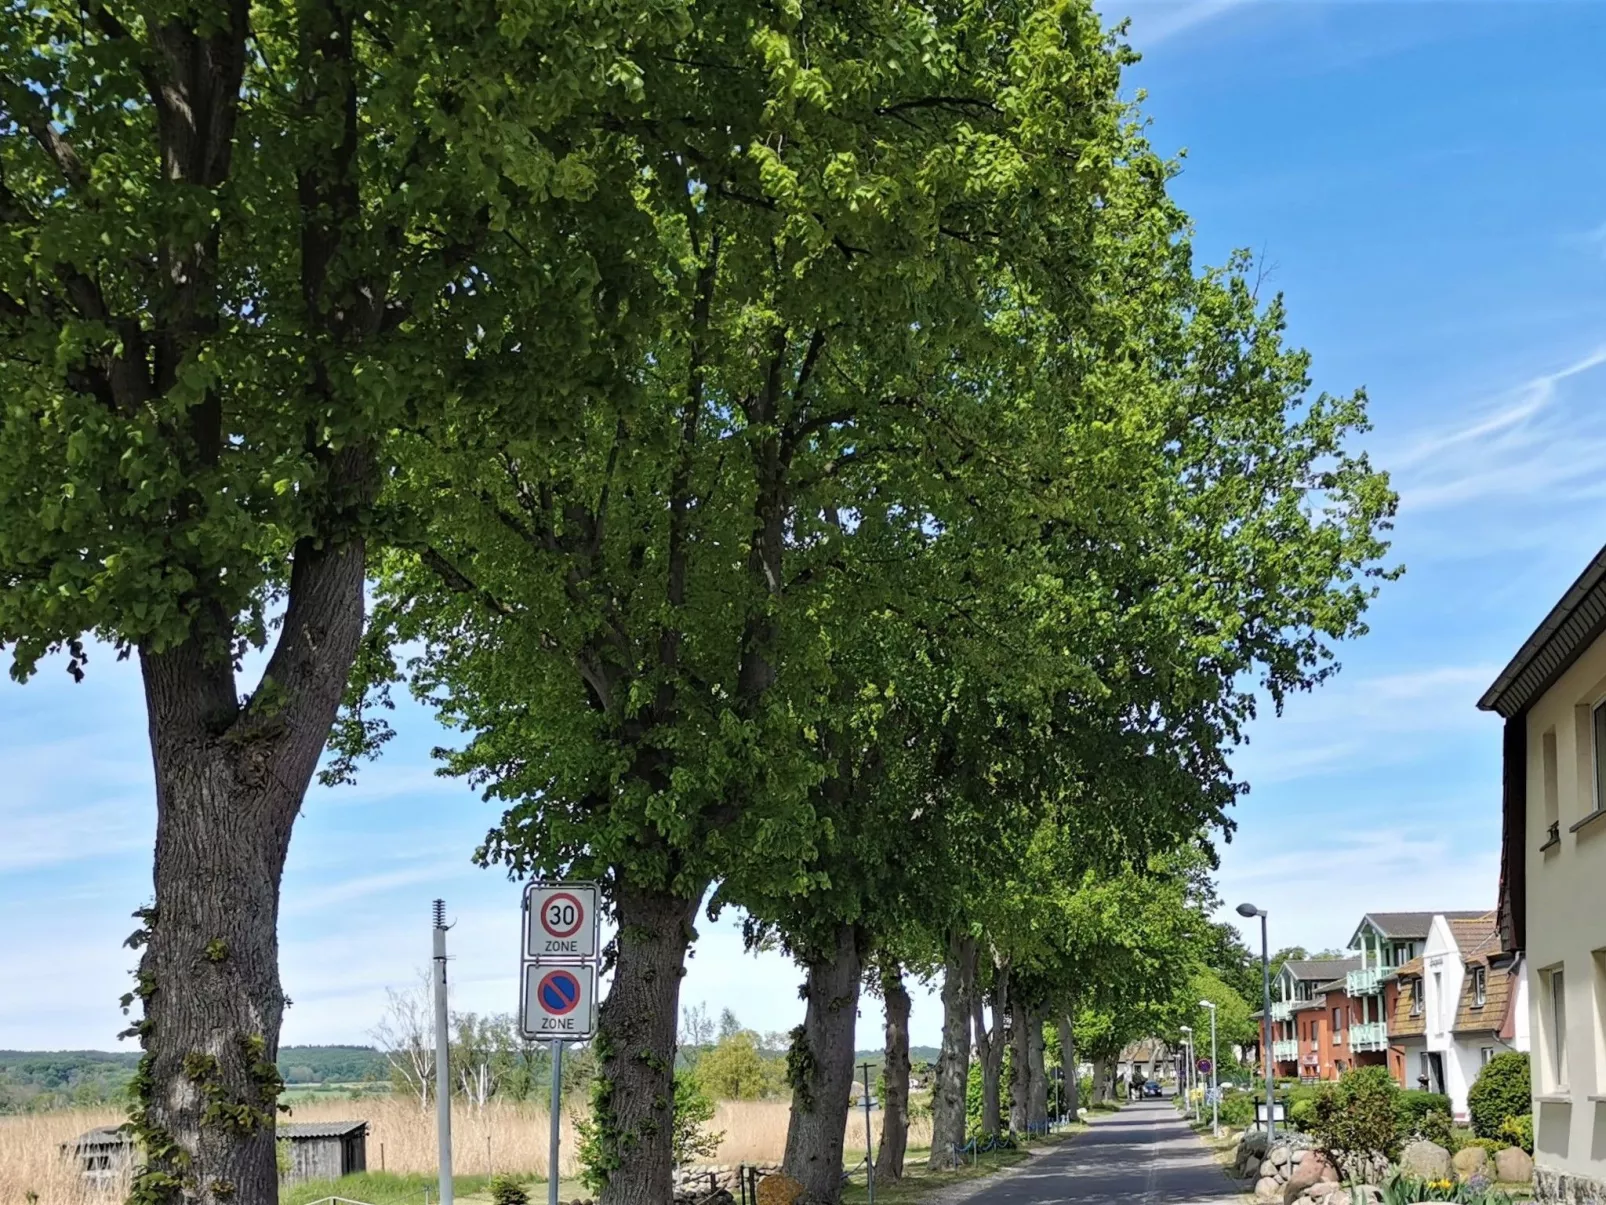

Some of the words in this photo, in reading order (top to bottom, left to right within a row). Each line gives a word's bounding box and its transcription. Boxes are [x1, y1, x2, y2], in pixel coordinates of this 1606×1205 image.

[550, 905, 574, 925] 30
[545, 941, 577, 951] ZONE
[541, 1018, 574, 1029] ZONE
